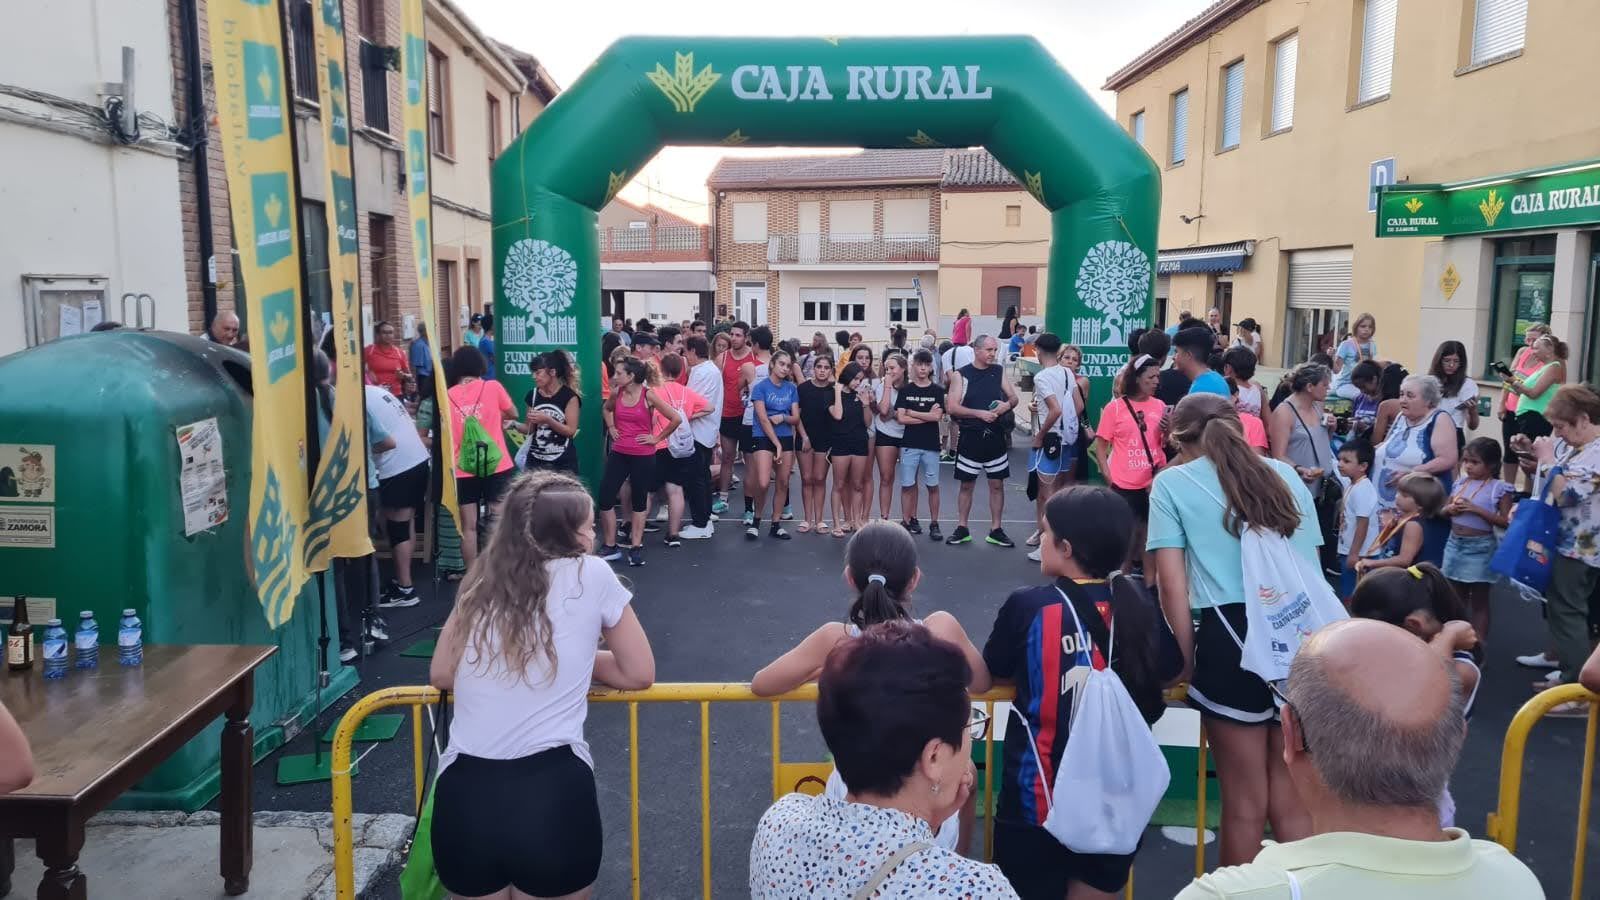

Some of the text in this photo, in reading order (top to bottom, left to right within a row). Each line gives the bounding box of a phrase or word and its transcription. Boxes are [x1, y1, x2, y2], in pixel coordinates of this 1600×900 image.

[731, 65, 992, 102] CAJA RURAL
[1511, 184, 1600, 214] CAJA RURAL
[1387, 217, 1439, 226] CAJA RURAL
[504, 363, 532, 375] CAJA
[1079, 365, 1103, 377] AJA
[8, 523, 48, 532] ZAMORA
